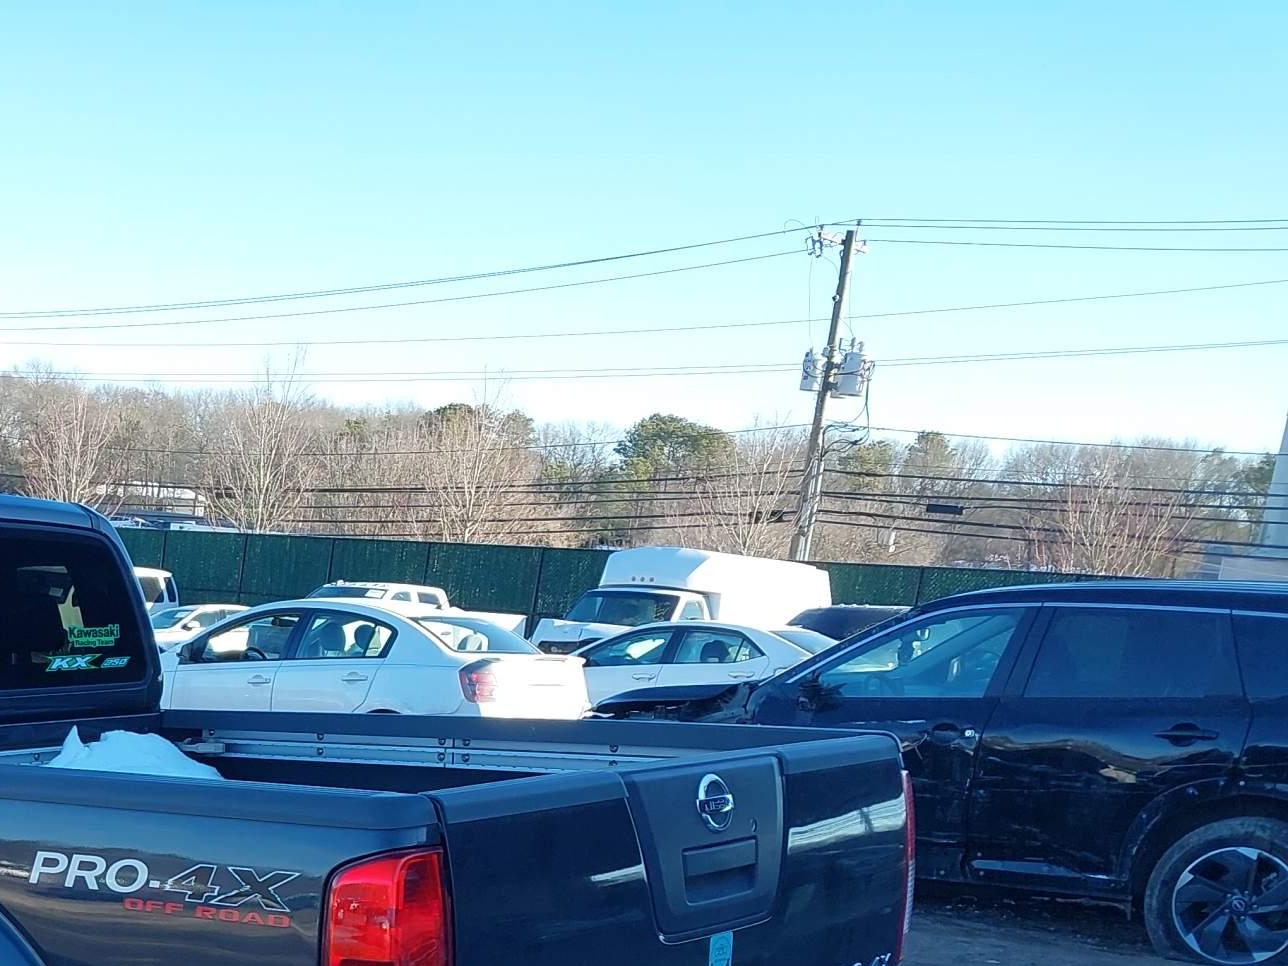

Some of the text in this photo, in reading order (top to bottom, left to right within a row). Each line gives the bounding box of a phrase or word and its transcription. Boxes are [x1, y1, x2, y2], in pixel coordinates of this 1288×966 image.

[68, 624, 120, 639] Kawasaki
[50, 655, 94, 670] KX
[28, 850, 301, 912] PRO-4X
[123, 897, 292, 928] OFF ROAD
